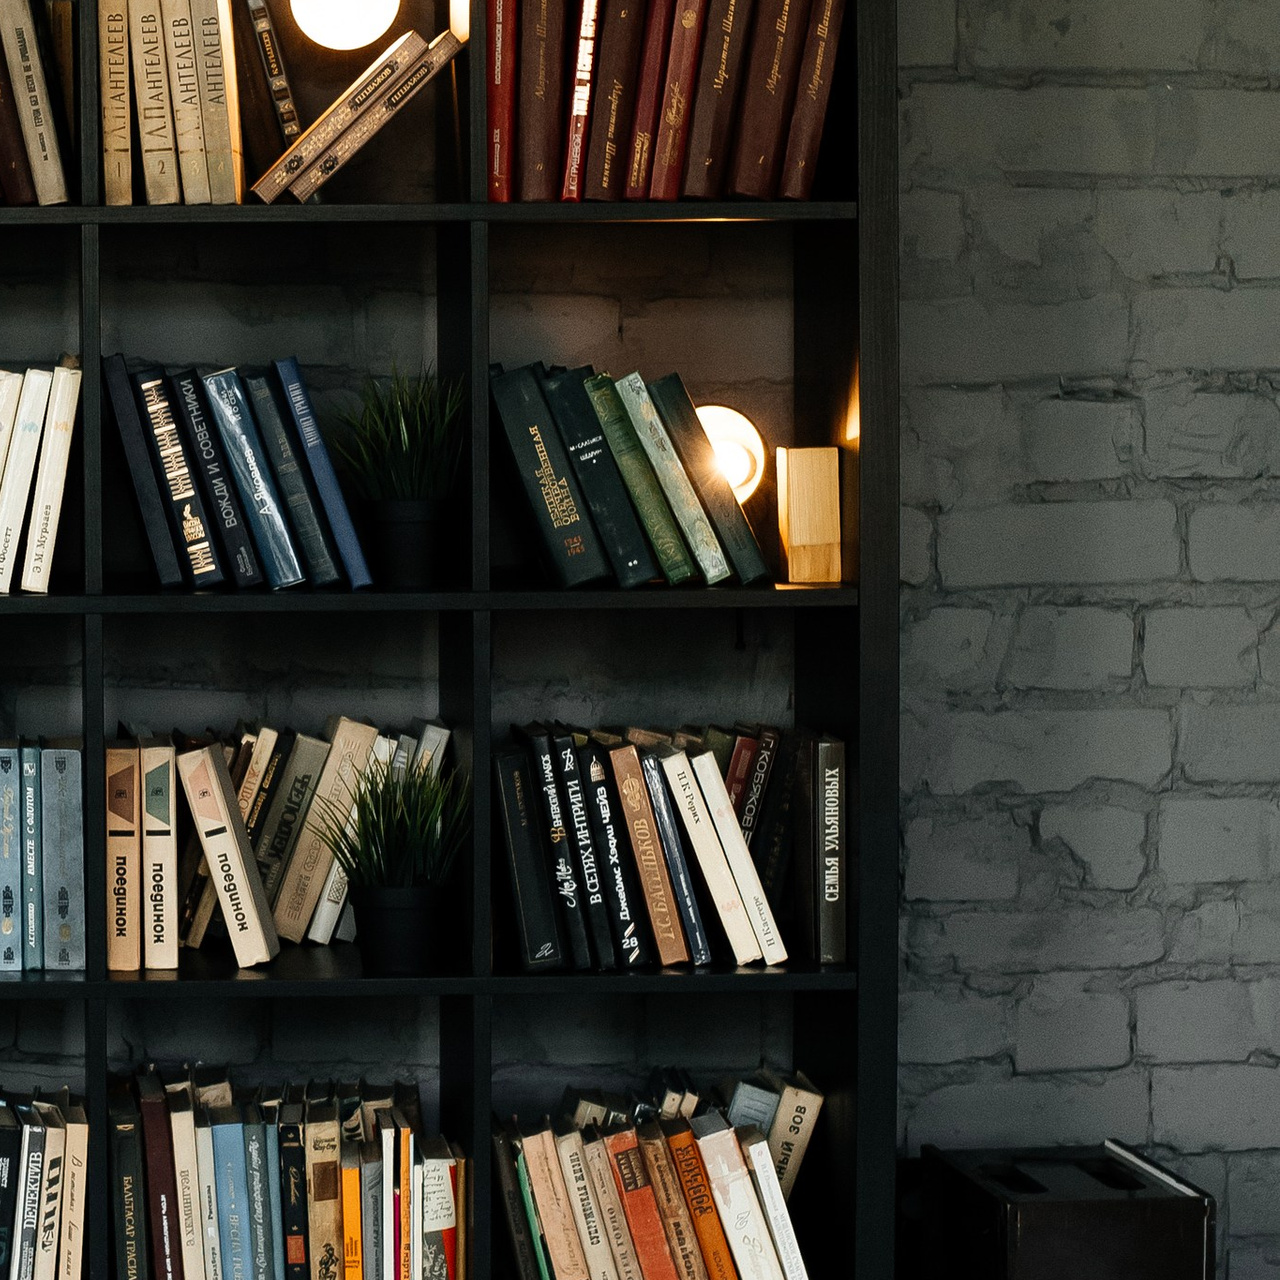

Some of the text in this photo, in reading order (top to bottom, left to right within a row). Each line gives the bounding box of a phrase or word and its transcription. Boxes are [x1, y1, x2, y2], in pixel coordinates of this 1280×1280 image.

[140, 13, 168, 139] Л.ПАНТЕЛЕЕВ
[713, 35, 731, 94] Мариэтта
[765, 36, 785, 95] Мариэтта
[806, 40, 826, 100] Мариэтта
[157, 159, 166, 175] 2
[180, 378, 238, 529] ВОЖДИ И СОВЕТНИКИ
[242, 448, 268, 501] Яковлев
[528, 424, 571, 527] ОТЕЧЕСТВЕННАЯ
[36, 504, 52, 549] Мурзаев
[534, 468, 562, 529] ВЕЛИКАЯ
[557, 476, 581, 524] ВОЙНА
[740, 749, 772, 828] КОБЯКОВ
[27, 838, 35, 876] ВМЕСТЕ
[566, 779, 603, 905] В СЕТЯХ ИНТРИГИ
[596, 785, 631, 921] Джеймс Хэдли ЧЕЙЗ
[633, 817, 668, 912] БАТЕНЬКОВ
[824, 767, 840, 903] СЕМЬЯ УЛЬЯНОВЫХ
[113, 855, 127, 937] поединок
[151, 862, 165, 944] поединок
[216, 852, 249, 932] поединок
[621, 937, 639, 949] 28
[787, 1104, 807, 1135] ЗОВ
[23, 1151, 42, 1230] ДЕТЕКТИВ
[569, 1150, 587, 1183] ЖИЗНЬ
[122, 1174, 136, 1239] БАЛЬТАСАР
[179, 1169, 194, 1236] ХЕМИНГУЭЙ
[576, 1184, 601, 1247] СУПРУЖЕСКАЯ
[606, 1206, 625, 1248] ГОРИО
